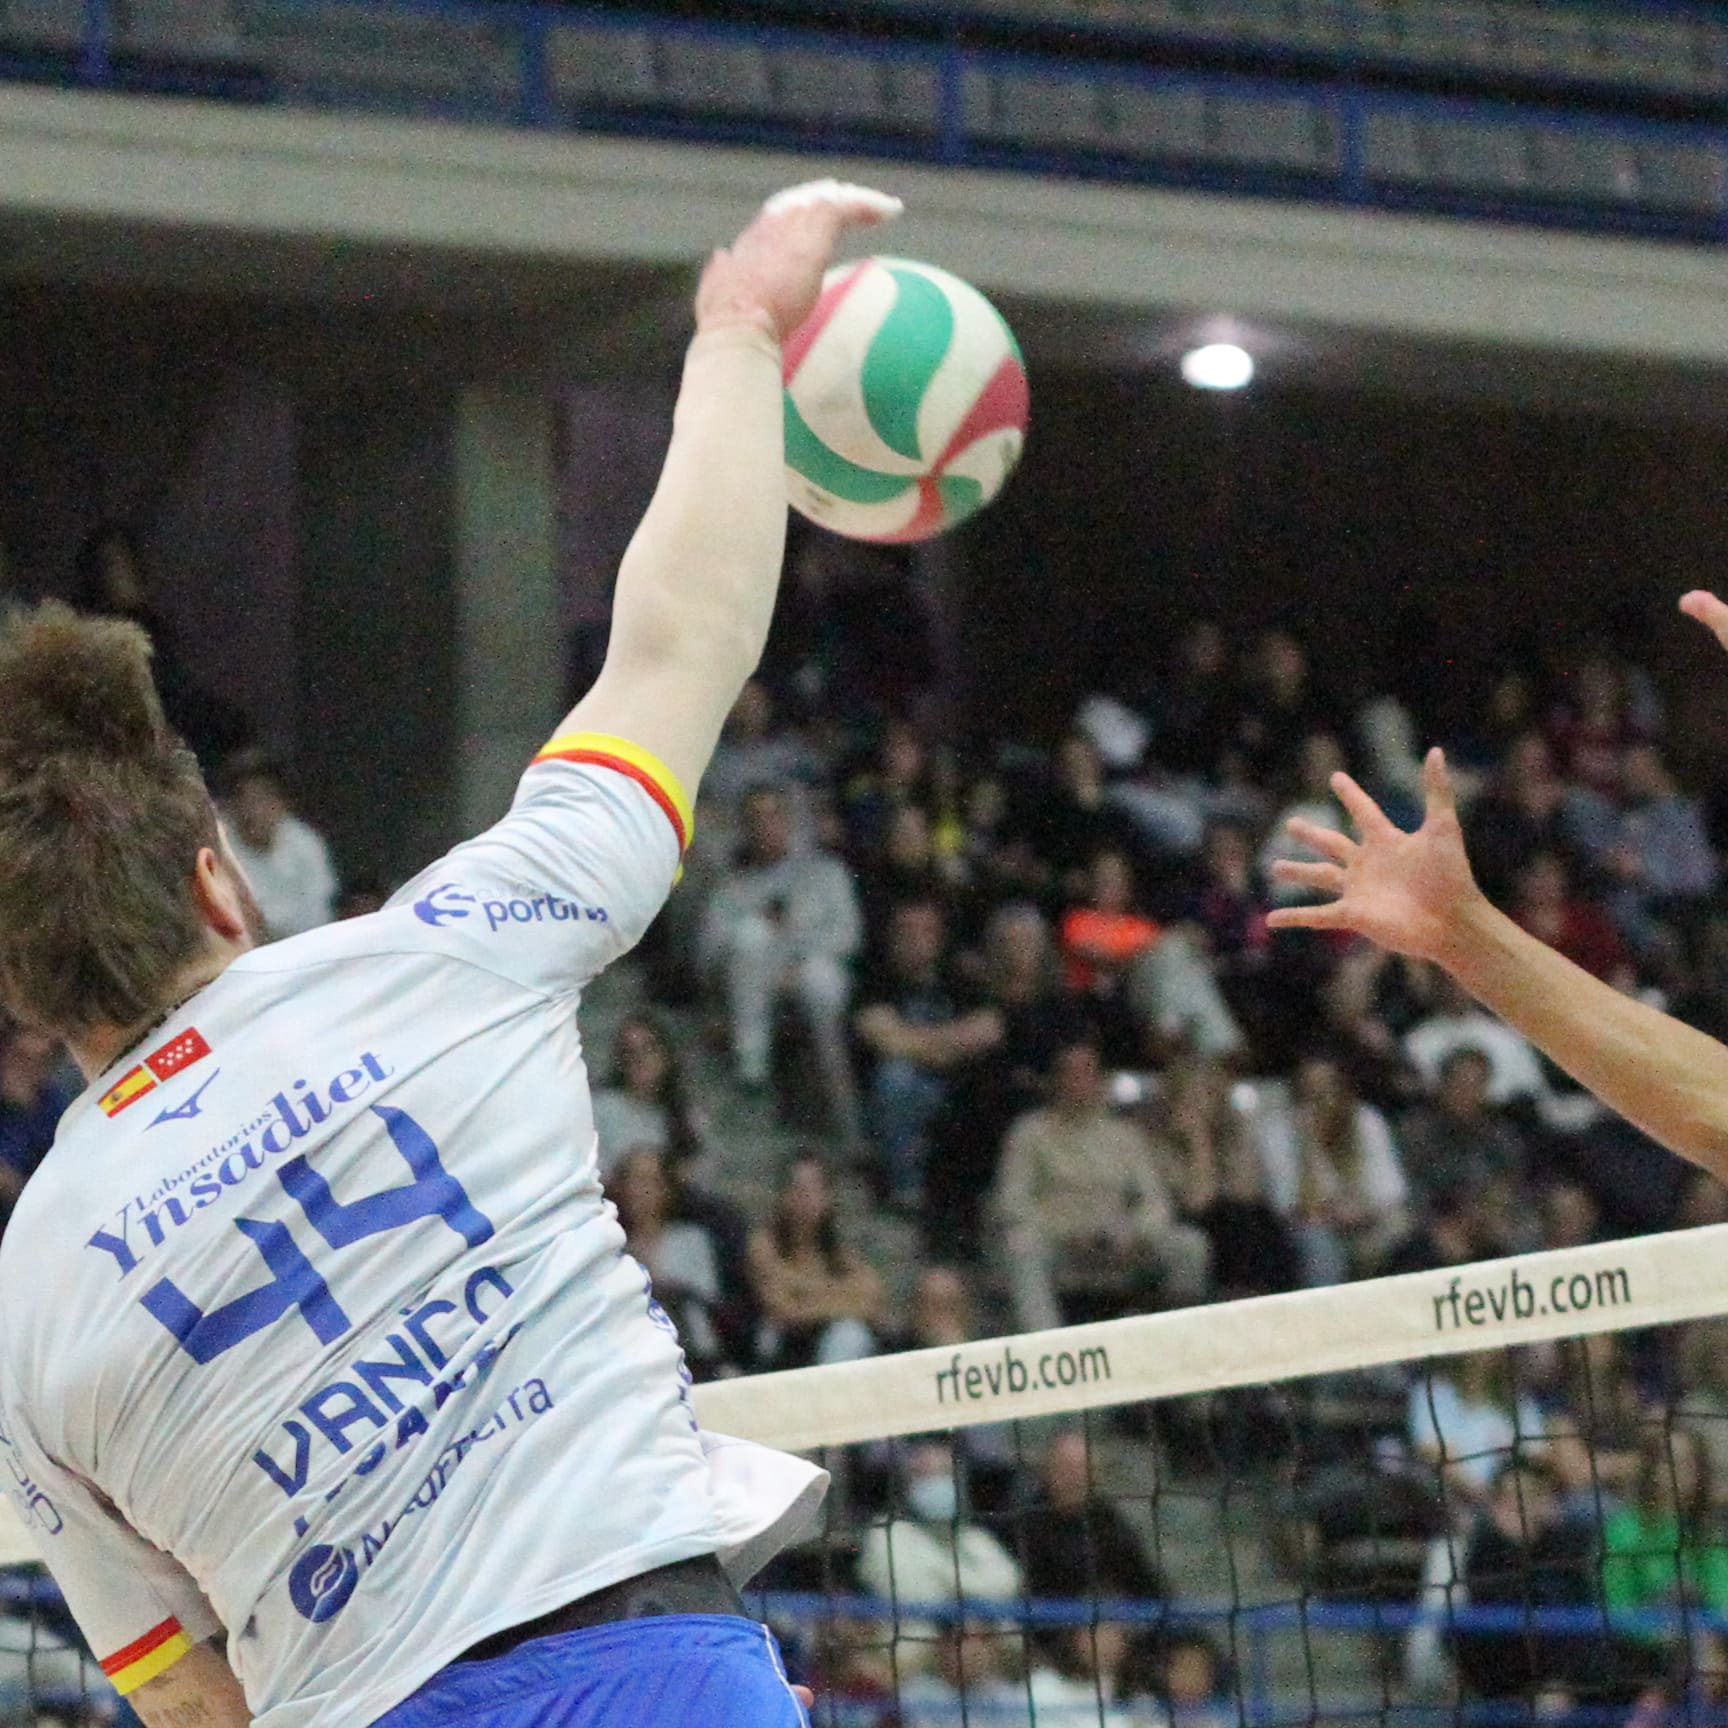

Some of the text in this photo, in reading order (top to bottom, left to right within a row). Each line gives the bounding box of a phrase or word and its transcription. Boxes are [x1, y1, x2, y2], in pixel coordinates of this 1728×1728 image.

[83, 1051, 395, 1283] Ynsadiet
[135, 1109, 273, 1212] Laboratorios
[139, 1103, 495, 1365] 44
[1431, 1266, 1633, 1333] rfevb.com
[933, 1344, 1113, 1405] rfevb.com
